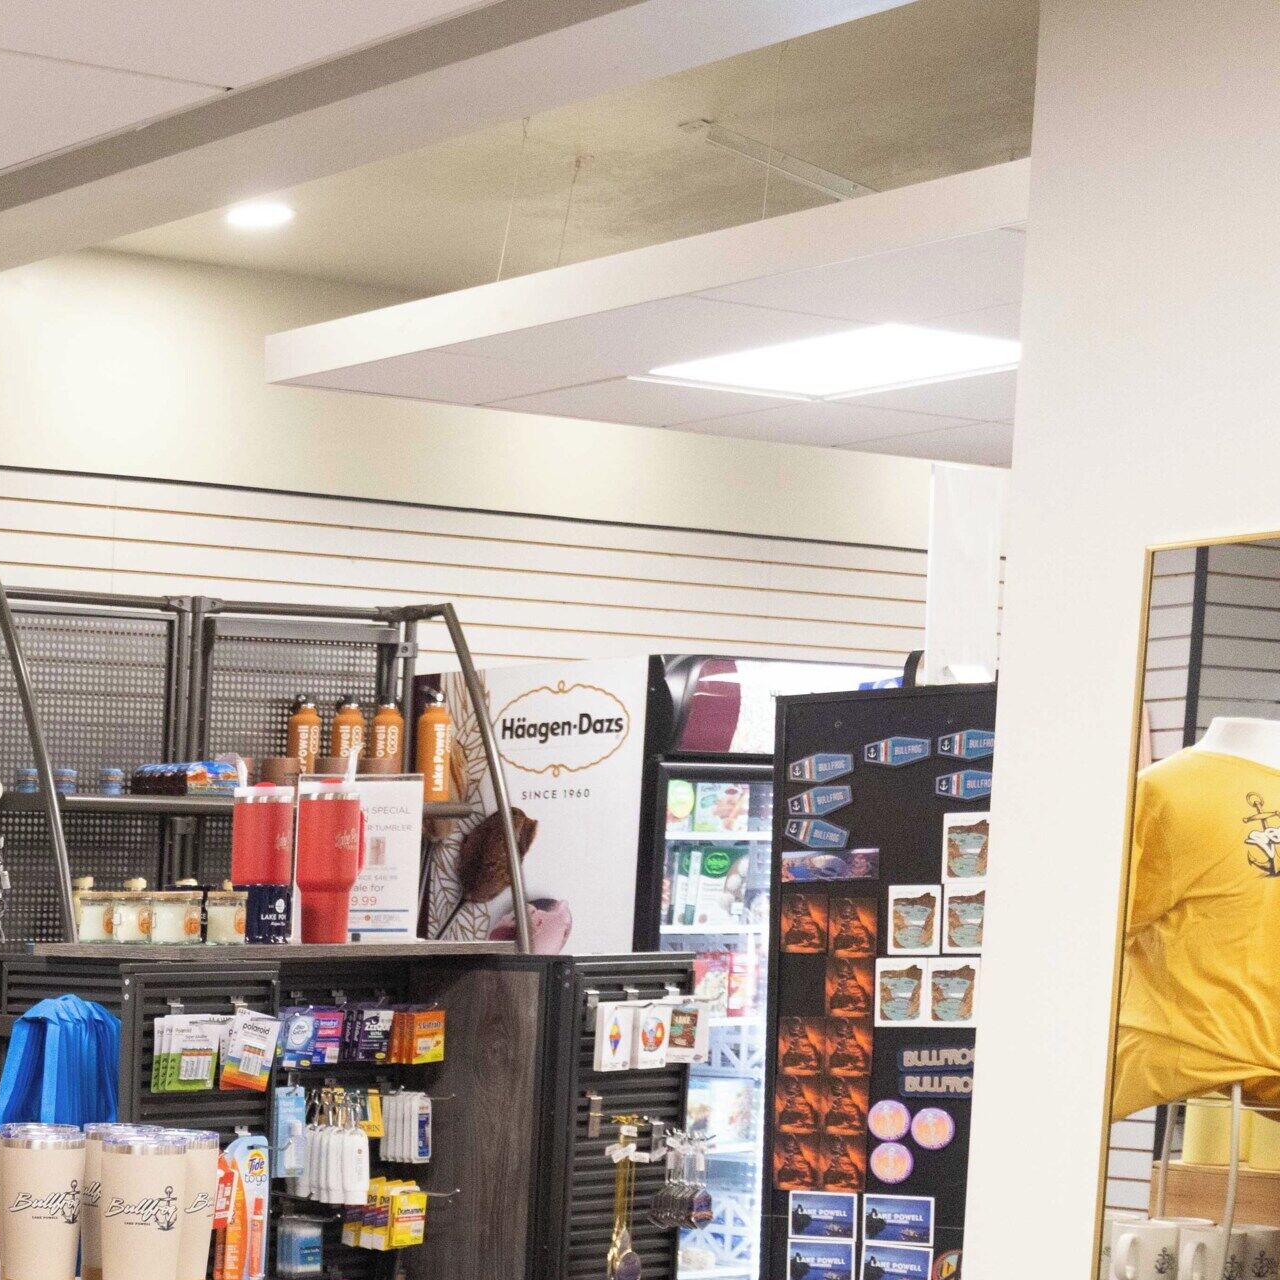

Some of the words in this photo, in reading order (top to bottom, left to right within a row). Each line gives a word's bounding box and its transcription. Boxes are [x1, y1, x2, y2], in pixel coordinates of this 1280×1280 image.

[966, 778, 992, 789] BULLFRO
[522, 789, 558, 800] SINCE
[563, 788, 591, 799] 1960
[371, 806, 411, 815] SPECIAL
[353, 884, 368, 892] ale
[351, 896, 378, 906] 9.99
[242, 1022, 271, 1035] polaroid
[905, 1076, 974, 1093] BULLFRO
[248, 1156, 265, 1173] Tide
[872, 1212, 892, 1220] LAKE
[893, 1214, 924, 1222] POWELL
[817, 1257, 846, 1265] POWELL
[870, 1260, 891, 1268] LAKE
[892, 1261, 922, 1272] POWELL
